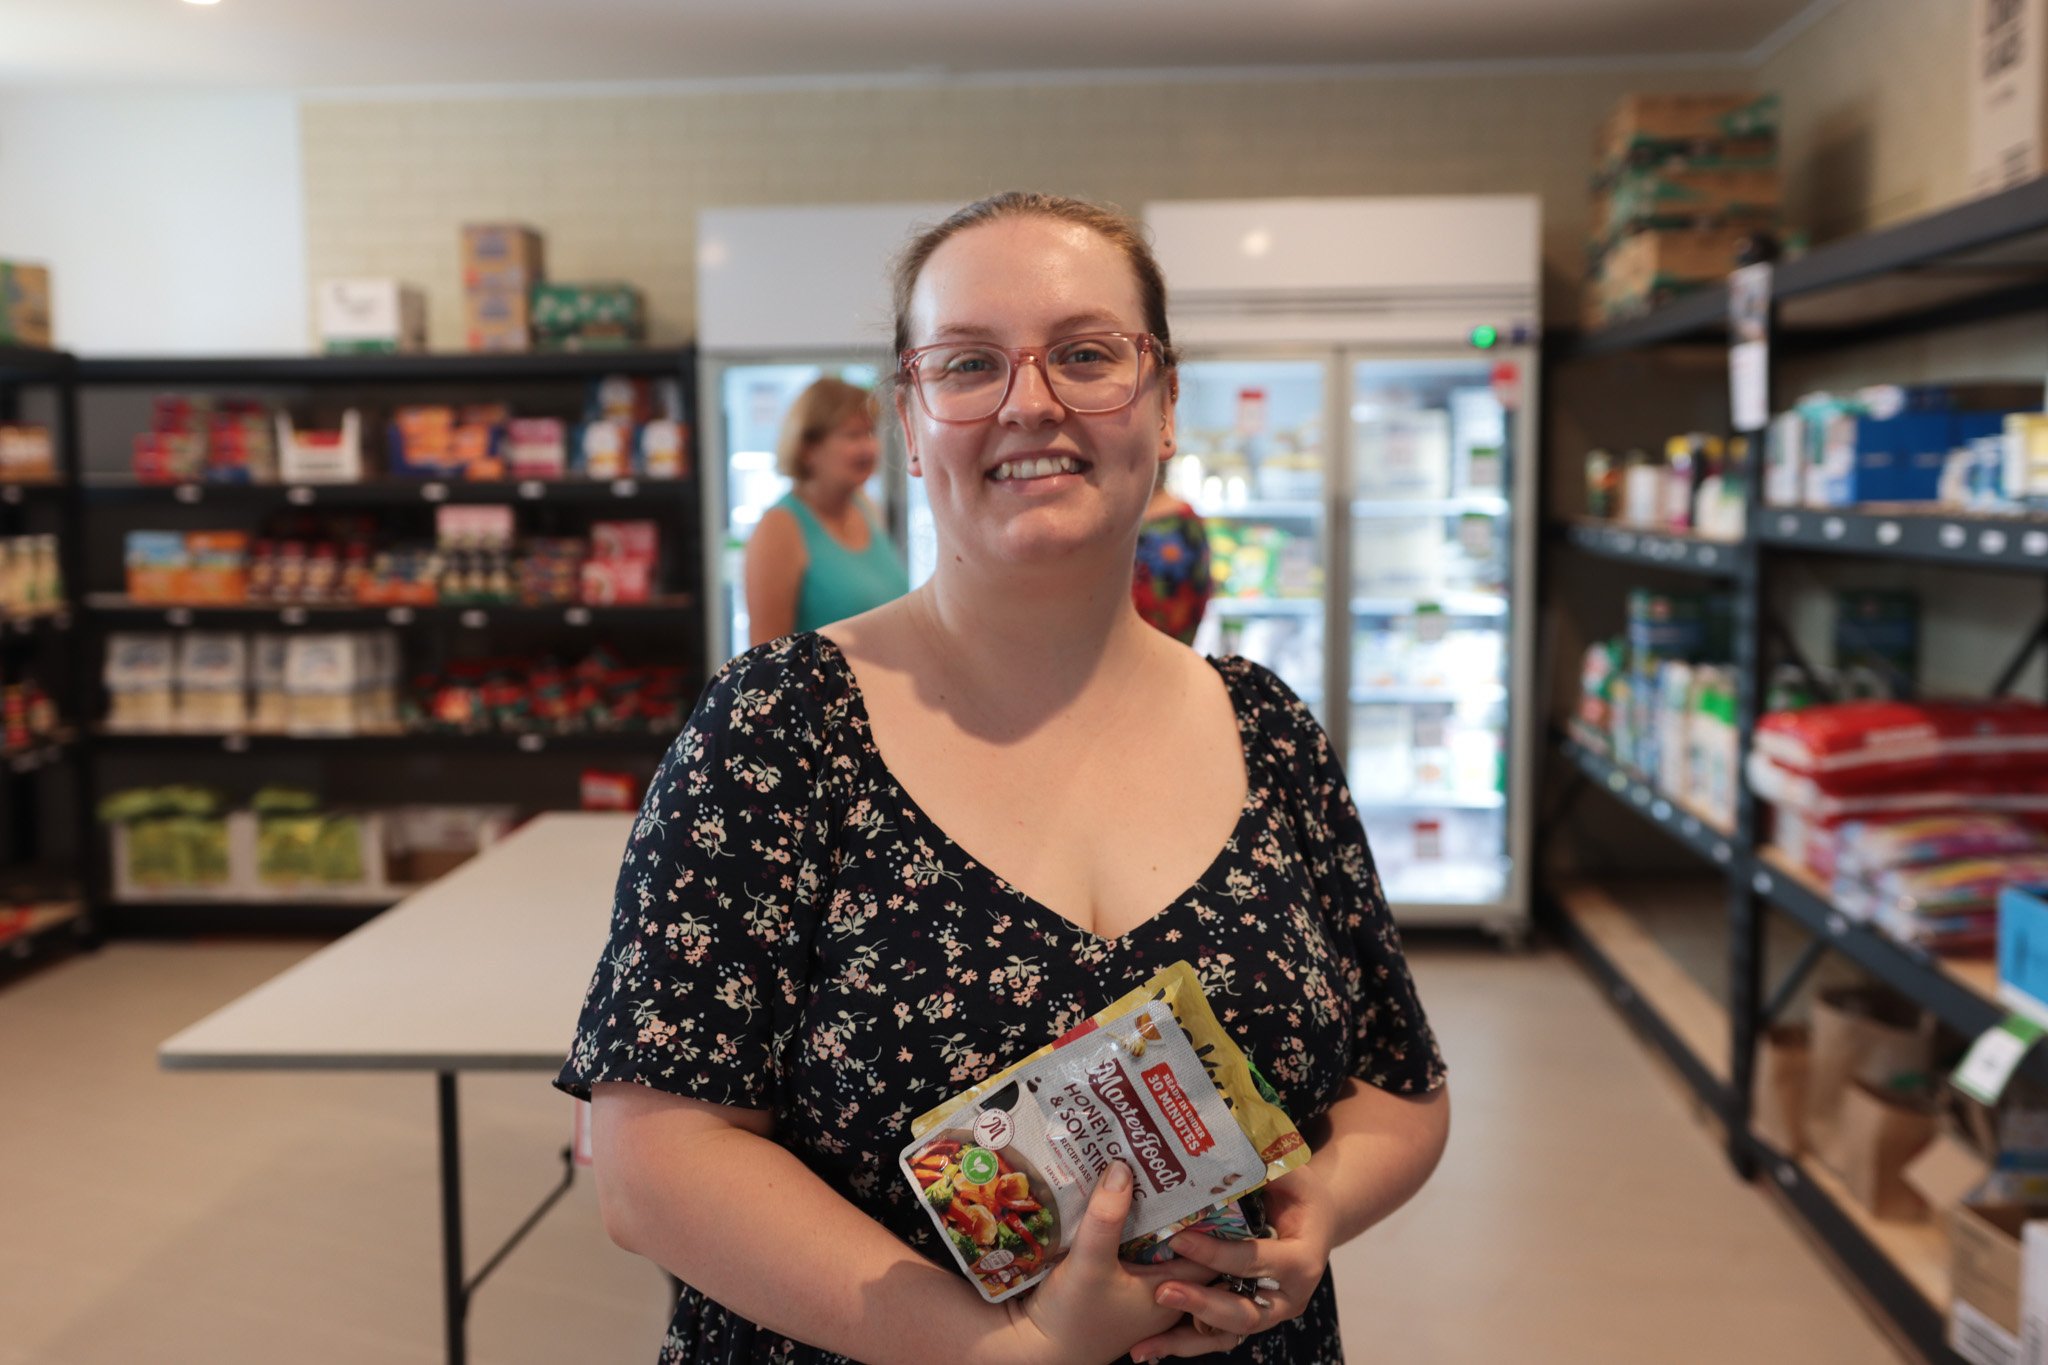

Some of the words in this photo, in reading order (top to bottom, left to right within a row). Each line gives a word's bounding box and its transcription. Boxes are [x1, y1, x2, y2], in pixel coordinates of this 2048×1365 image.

[1050, 1096, 1064, 1108] &
[1060, 1107, 1090, 1141] SOY
[1063, 1083, 1112, 1142] HONEY,
[1086, 1059, 1181, 1192] MasterFoods
[1148, 1073, 1164, 1091] 30
[1158, 1091, 1200, 1151] MINUTES
[1163, 1073, 1181, 1100] READY
[1179, 1096, 1189, 1111] IN
[1186, 1111, 1206, 1139] UNDER
[1061, 1137, 1081, 1165] RECIPE
[1079, 1163, 1093, 1184] BASE
